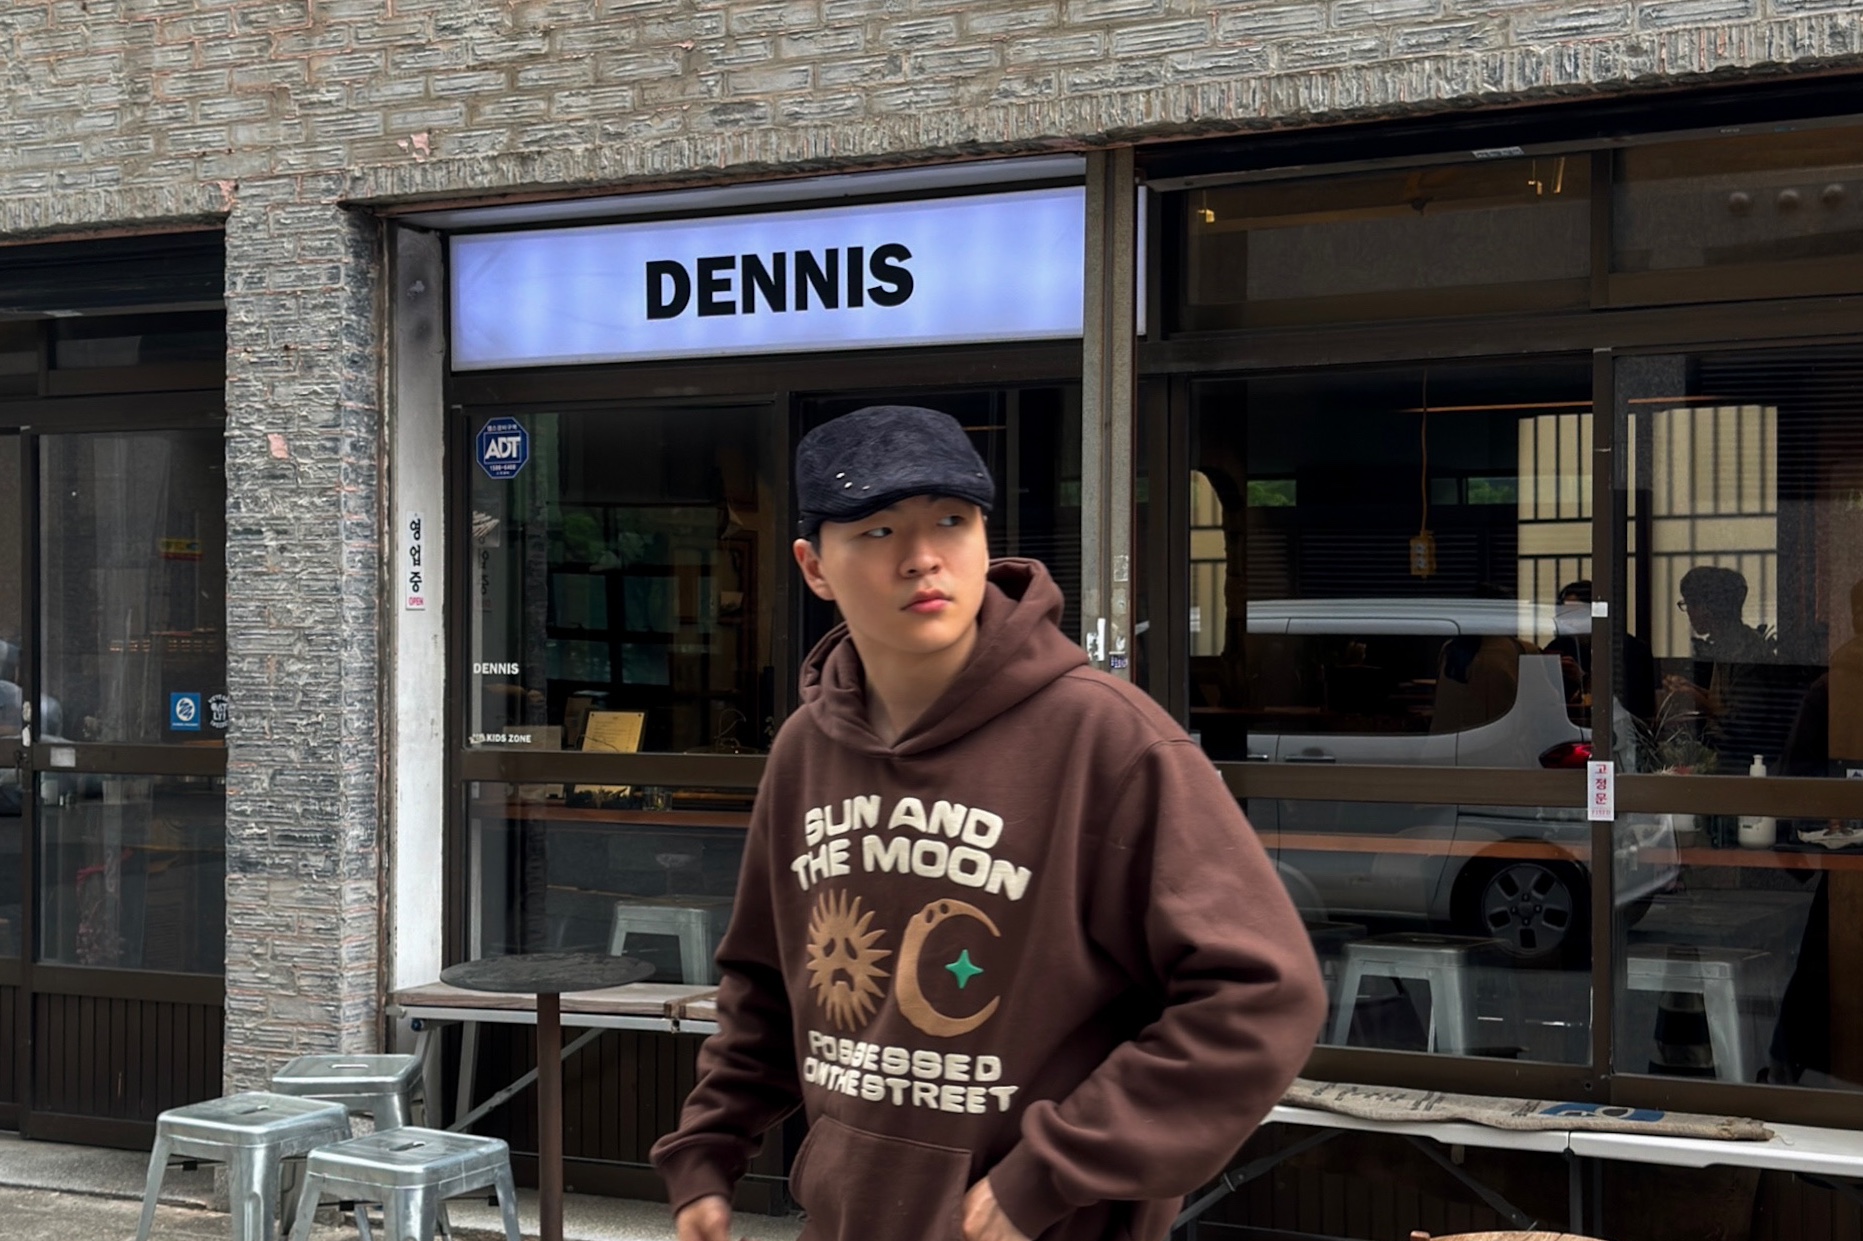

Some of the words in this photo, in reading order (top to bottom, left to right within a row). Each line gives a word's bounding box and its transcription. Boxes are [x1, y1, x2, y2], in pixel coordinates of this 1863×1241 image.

[646, 243, 914, 320] DENNIS
[485, 436, 521, 459] ADT
[409, 518, 422, 593] 영업중
[408, 597, 424, 606] OPEN
[473, 662, 520, 675] DENNIS
[486, 734, 507, 742] KIDS
[508, 734, 532, 743] ZONE
[1595, 764, 1607, 805] 고정문
[804, 794, 881, 847] SUN
[888, 797, 1004, 849] AND
[790, 838, 851, 891] THE
[862, 834, 1033, 901] MOON
[808, 1030, 1002, 1082] POSSESSED
